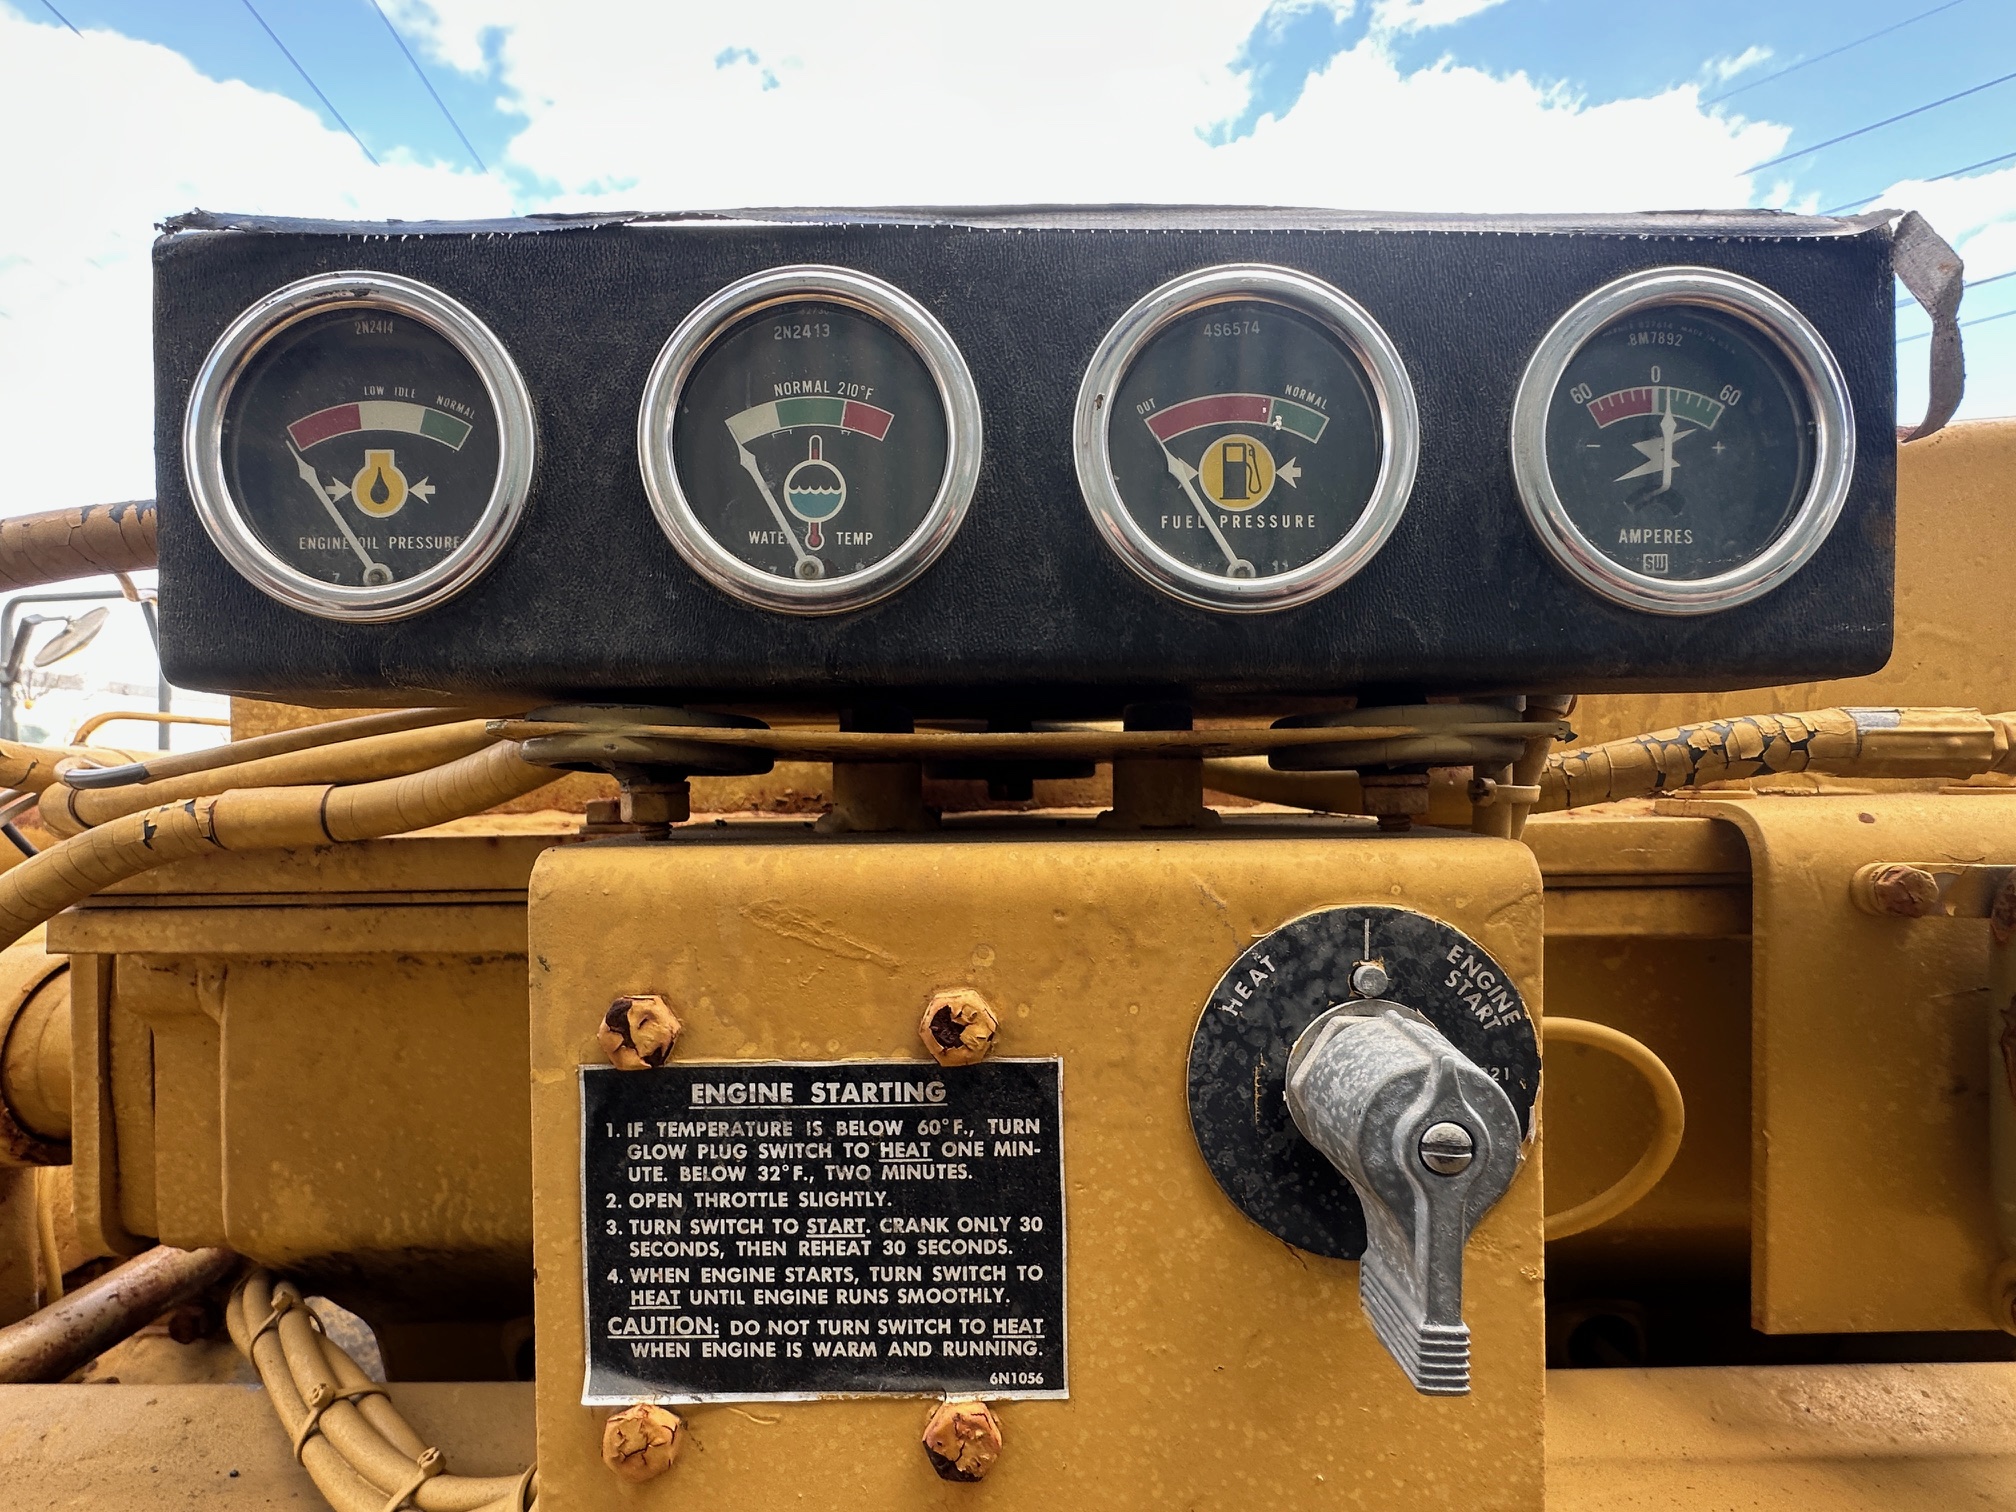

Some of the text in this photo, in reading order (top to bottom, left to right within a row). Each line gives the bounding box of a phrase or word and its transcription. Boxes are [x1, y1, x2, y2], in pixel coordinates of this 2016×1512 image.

[355, 321, 394, 335] 2N2414
[774, 324, 831, 340] 2N2413
[1203, 321, 1260, 337] 4S6574
[1651, 366, 1661, 383] 0
[364, 386, 416, 398] LOW IDLE
[774, 380, 874, 400] NORMAL 210°F
[1284, 384, 1328, 410] NORMAL
[1570, 383, 1593, 406] 60
[1719, 384, 1742, 407] 60
[436, 395, 476, 419] NORMAL
[1136, 397, 1157, 416] OUT
[1161, 514, 1315, 529] FUEL PRESSURE
[299, 536, 461, 550] ENGINE OIL PRESSURE
[748, 531, 873, 546] WATE TEMP
[1618, 529, 1693, 544] AMPERES
[1223, 954, 1278, 1018] HEAT
[1445, 945, 1522, 1028] ENGINE
[1444, 969, 1503, 1031] START
[692, 1082, 945, 1103] ENGINE STARTING
[607, 1123, 619, 1137] 1.
[628, 1122, 643, 1137] IF
[657, 1121, 792, 1137] TEMPERATURE
[807, 1121, 822, 1136] IS
[837, 1120, 903, 1136] BELOW
[988, 1119, 1039, 1134] TURN
[628, 1141, 1040, 1160] GLOW PLUG SWITCH TO HEAT ONE MIN-
[629, 1166, 667, 1181] UTE.
[680, 1165, 746, 1181] BELOW
[825, 1165, 871, 1180] TWO
[883, 1164, 972, 1180] MINUTES.
[606, 1191, 891, 1208] 2. OPEN THROTTLE SLIGHTLY.
[606, 1217, 1042, 1235] 3. TURN SWITCH TO START. CRANK ONLY 30
[630, 1239, 1012, 1259] SECONDS, THEN REHEAT 30 SECONDS.
[607, 1265, 1043, 1284] 4. WHEN ENGINE STARTS, TURN SWITCH TO
[631, 1288, 1010, 1305] HEAT UNTIL ENGINE RUNS SMOOTHLY.
[608, 1316, 1043, 1335] CAUTION: DO NOT TURN SWITCH TO HEAT
[631, 1340, 1043, 1357] WHEN ENGINE IS WARM AND RUNNING.
[990, 1372, 1043, 1385] 6N1056
